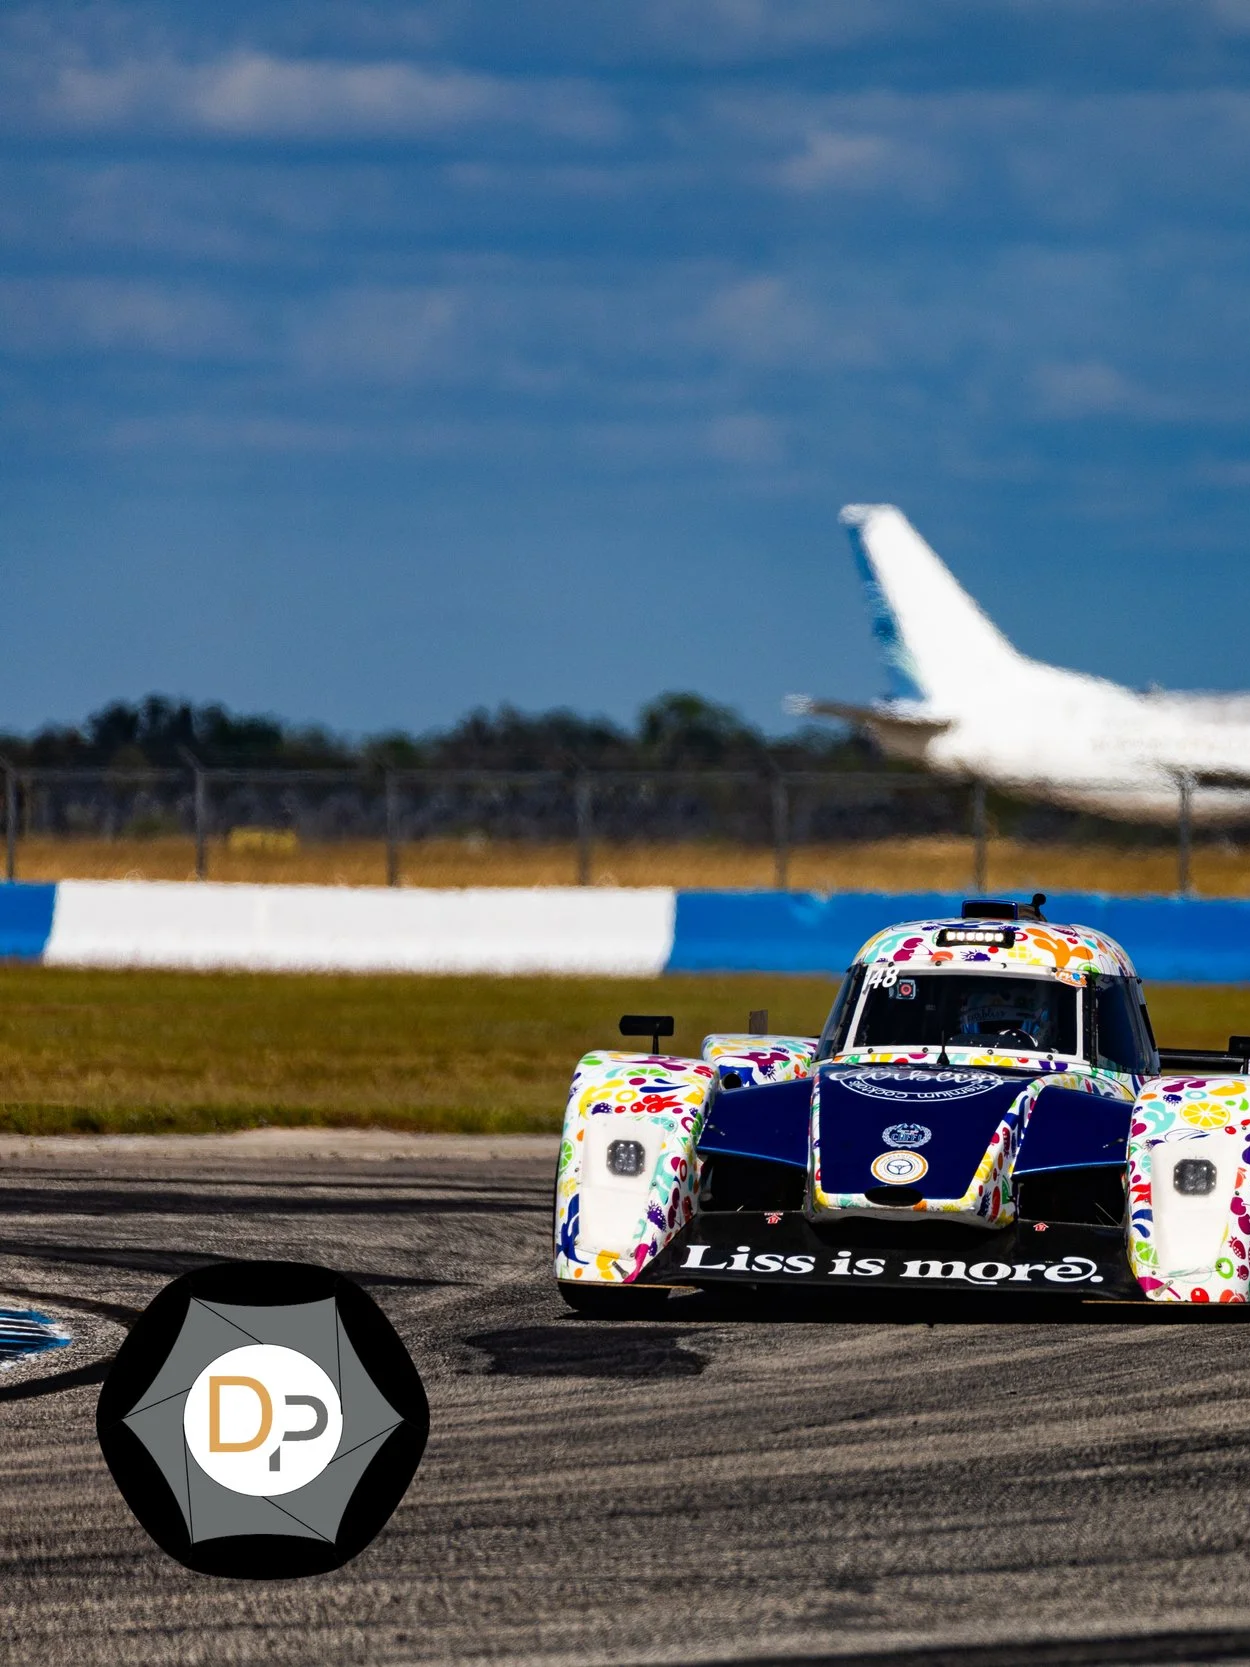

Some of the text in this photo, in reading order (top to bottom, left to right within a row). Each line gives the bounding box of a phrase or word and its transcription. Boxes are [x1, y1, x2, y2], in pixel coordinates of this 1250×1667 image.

[680, 1245, 1104, 1285] Liss is more.
